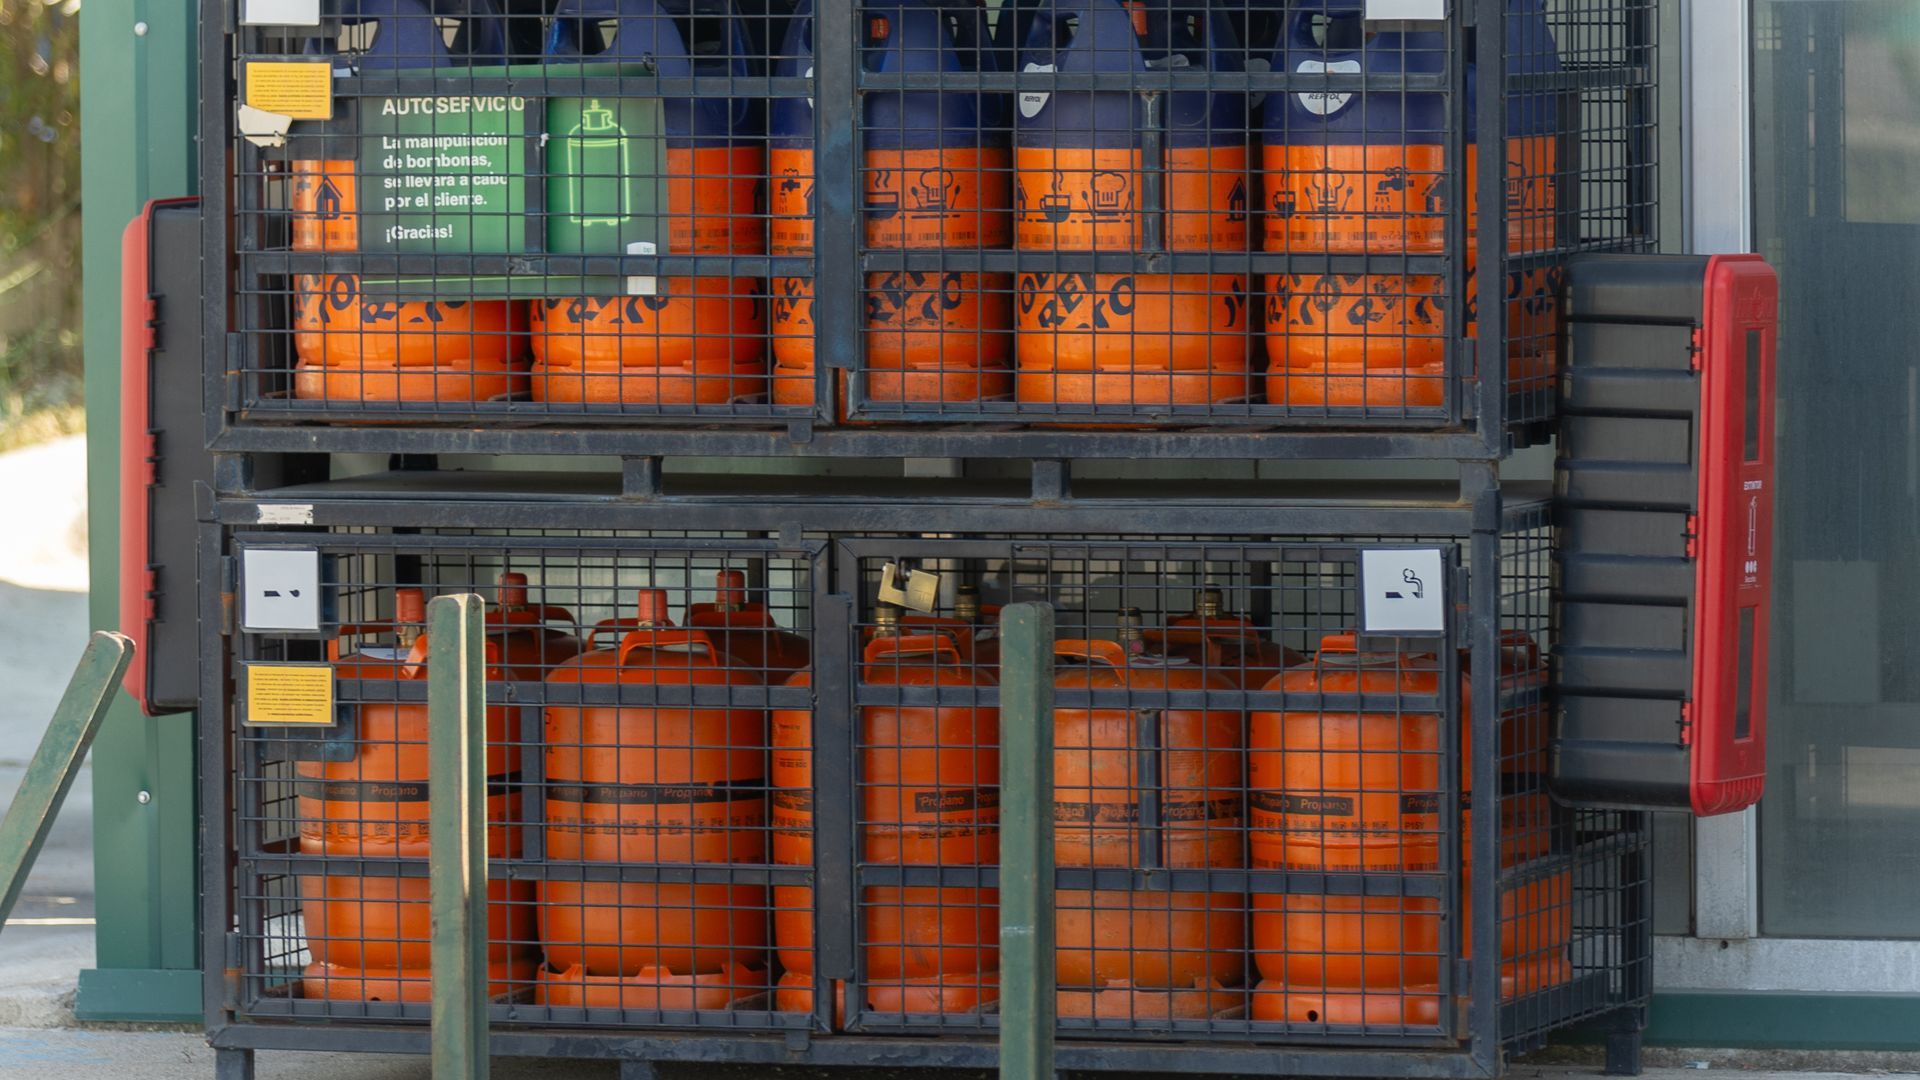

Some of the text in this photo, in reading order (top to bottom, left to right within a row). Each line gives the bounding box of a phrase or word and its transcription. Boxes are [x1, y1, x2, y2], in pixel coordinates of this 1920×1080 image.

[382, 136, 400, 149] La
[383, 155, 403, 169] de
[459, 175, 469, 186] a
[415, 193, 429, 207] el
